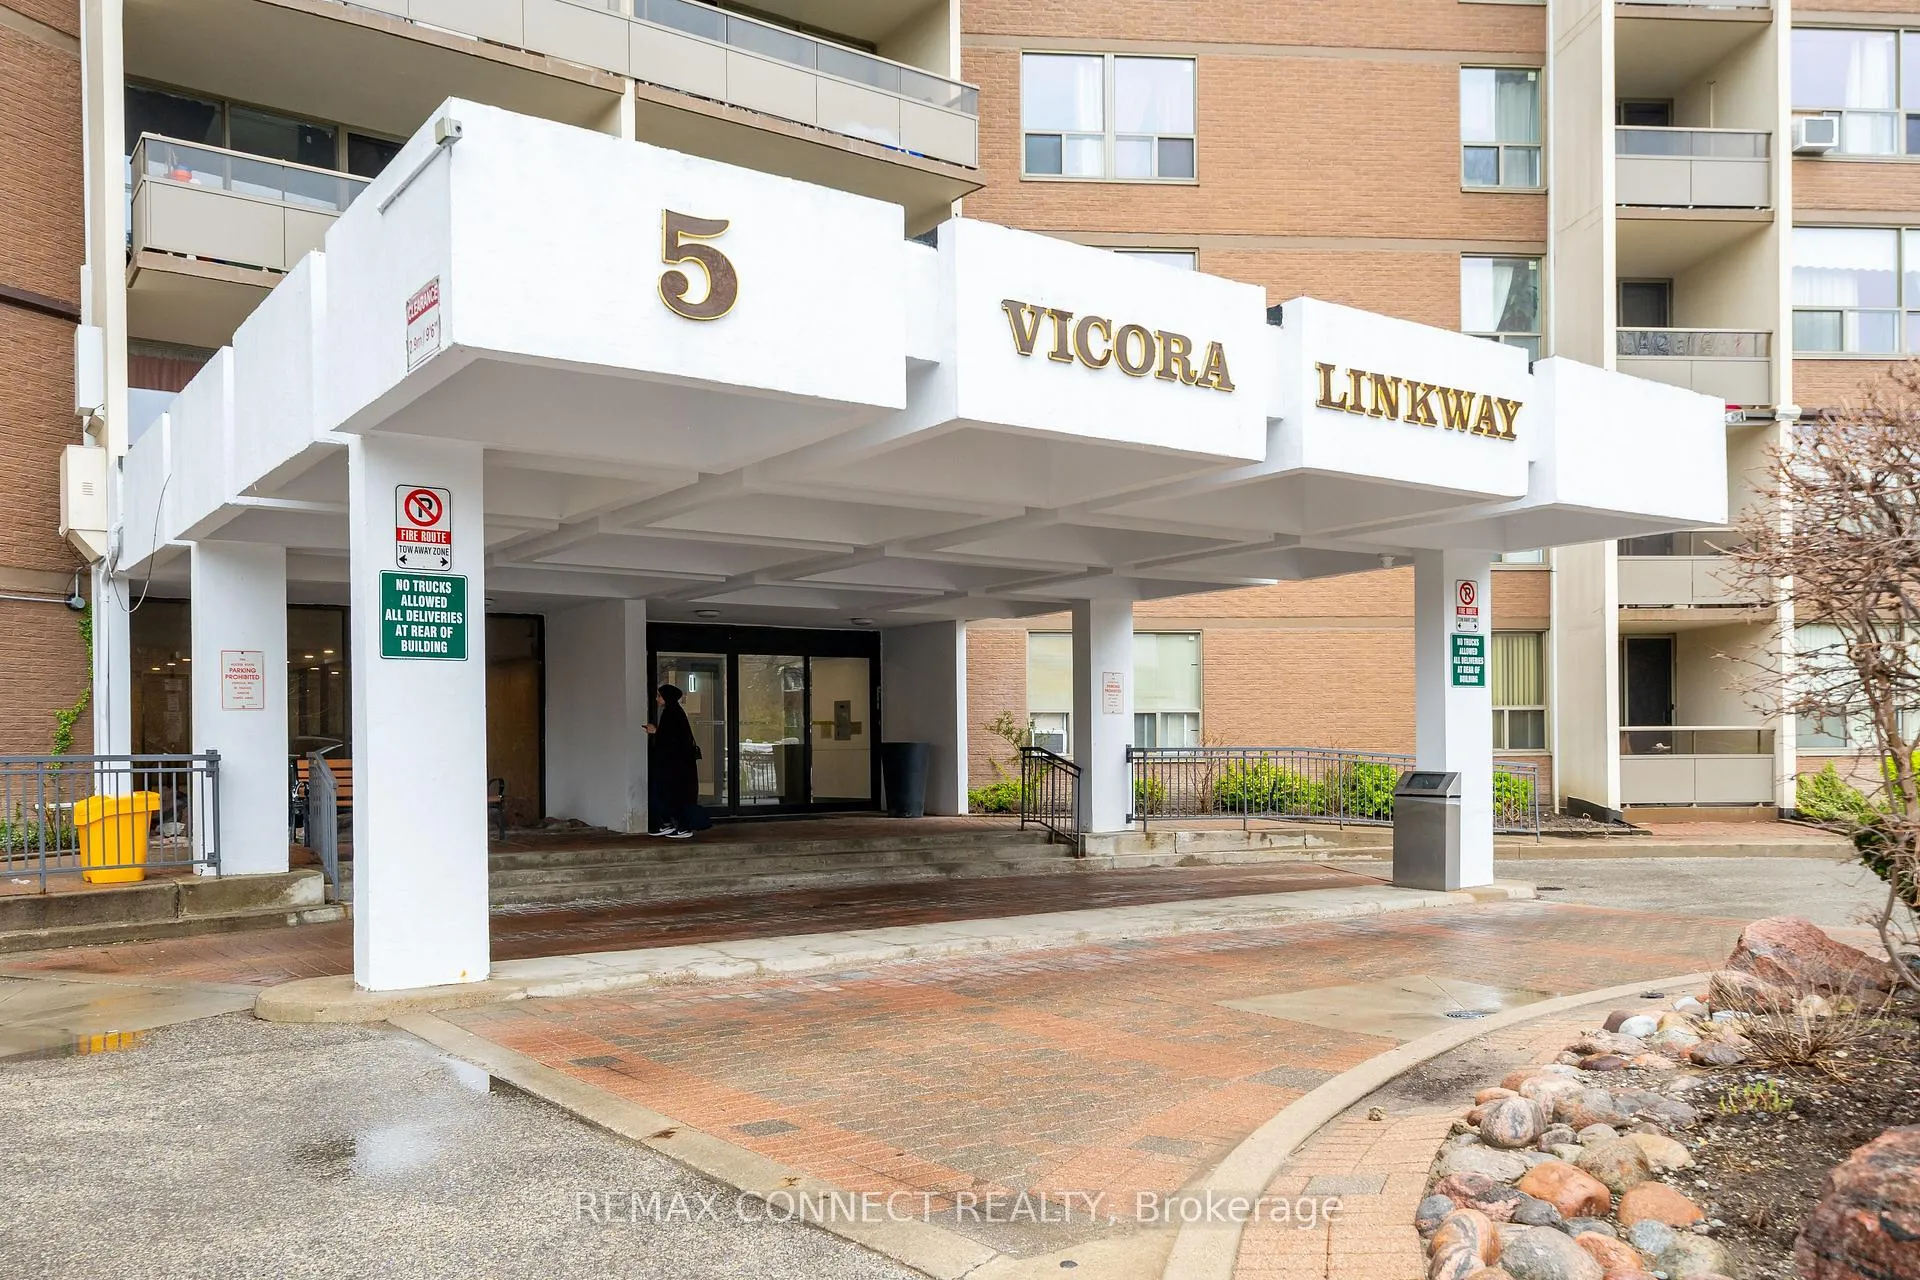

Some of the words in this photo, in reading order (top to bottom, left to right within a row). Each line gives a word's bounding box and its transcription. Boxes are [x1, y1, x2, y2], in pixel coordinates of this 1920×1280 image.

[658, 208, 738, 321] 5
[1001, 299, 1236, 392] VICORA
[1315, 361, 1524, 441] LINKWAY
[401, 529, 418, 542] FIRE
[421, 530, 447, 544] ROUTE
[399, 545, 414, 554] TOW
[414, 546, 432, 555] AWAY
[433, 546, 449, 556] ZONE
[396, 579, 410, 592] NO
[412, 579, 452, 594] TRUCKS
[401, 594, 448, 609] ALLOWED
[385, 608, 403, 622] ALL
[406, 609, 463, 624] DELIVERIES
[395, 624, 408, 637] AT
[411, 625, 437, 638] REAR
[440, 626, 453, 639] OF
[401, 639, 448, 653] BUILDING
